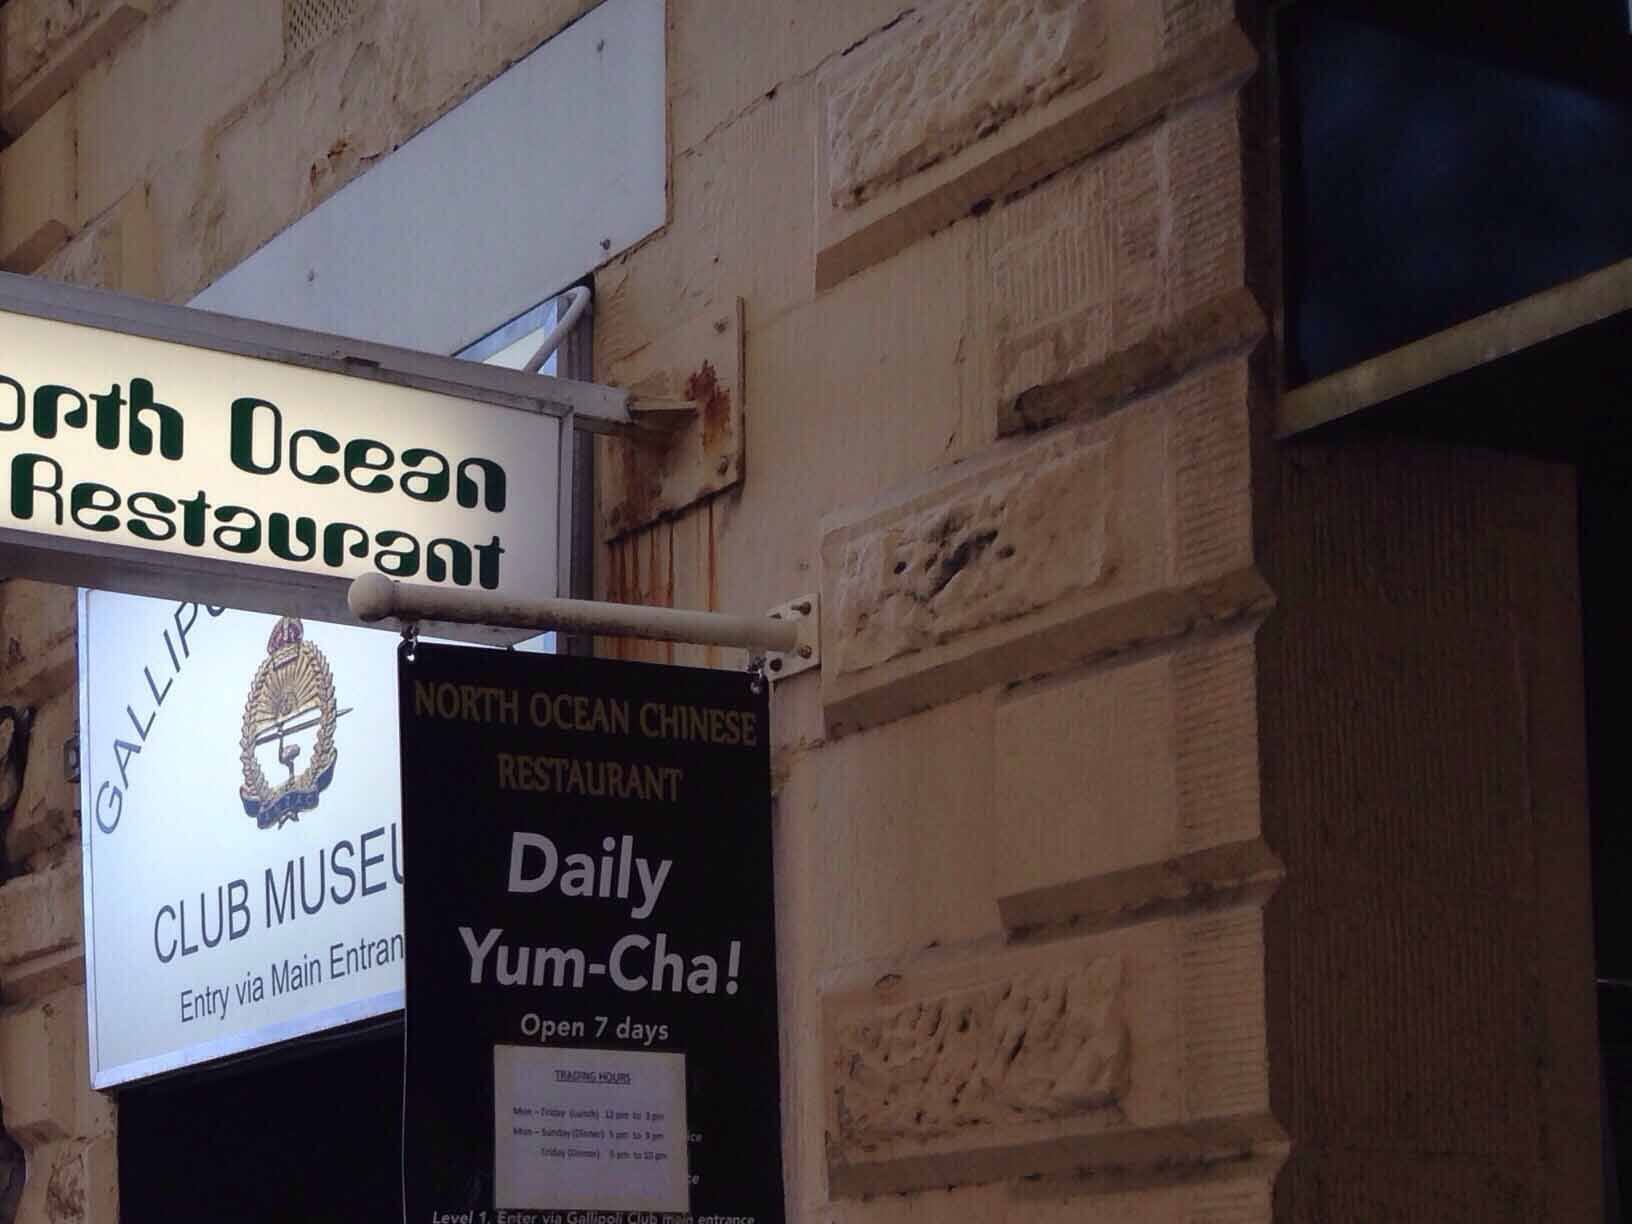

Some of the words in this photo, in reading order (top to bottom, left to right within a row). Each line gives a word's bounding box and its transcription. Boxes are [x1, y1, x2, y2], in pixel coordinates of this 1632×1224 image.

[230, 396, 507, 514] Ocean
[10, 451, 506, 590] Restaurant
[95, 600, 224, 834] GALLIP
[414, 680, 521, 726] NORTH
[528, 691, 631, 736] OCEAN
[638, 701, 758, 747] CHINESE
[496, 752, 685, 802] RESTAURANT
[508, 831, 673, 920] Daily
[154, 878, 252, 964] CLUB
[458, 926, 742, 995] Yum-Cha!
[180, 988, 230, 1023] Entry
[235, 971, 265, 1006] via
[271, 954, 322, 997] Main
[329, 932, 405, 980] Entran
[520, 1012, 585, 1042] Open
[593, 1015, 608, 1039] 7
[615, 1015, 670, 1046] days
[554, 1069, 597, 1082] TRADING
[598, 1071, 632, 1085] HOURS
